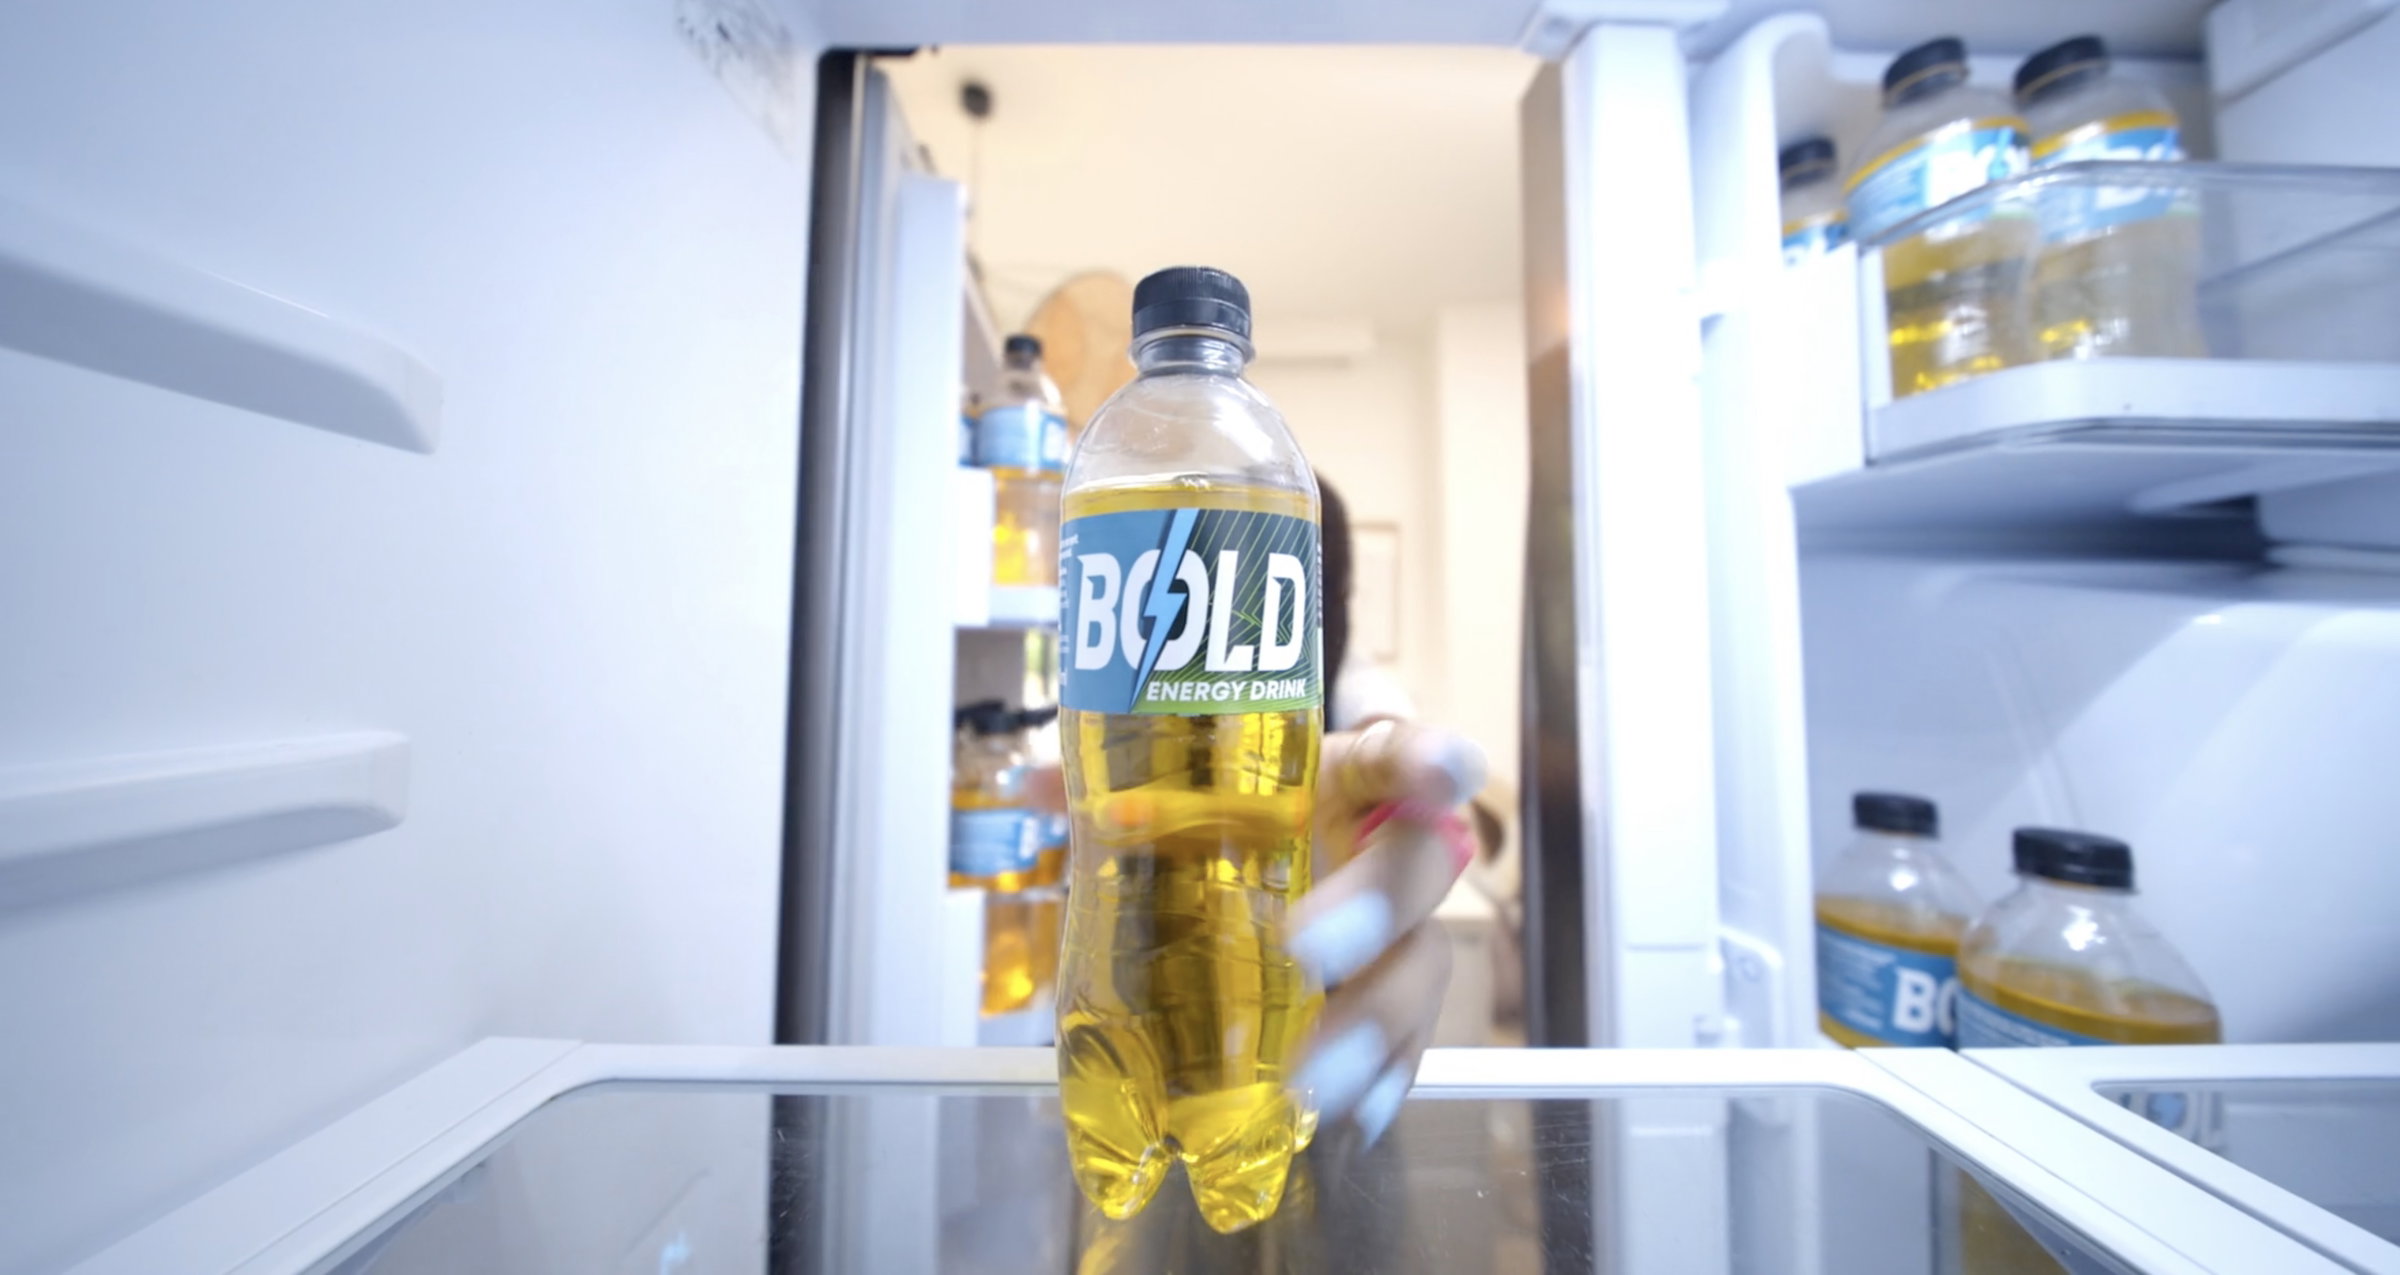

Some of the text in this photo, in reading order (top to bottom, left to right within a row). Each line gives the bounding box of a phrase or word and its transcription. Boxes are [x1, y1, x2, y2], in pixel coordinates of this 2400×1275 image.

[1075, 549, 1306, 671] BOLD
[1147, 679, 1307, 701] ENERGY DRINK
